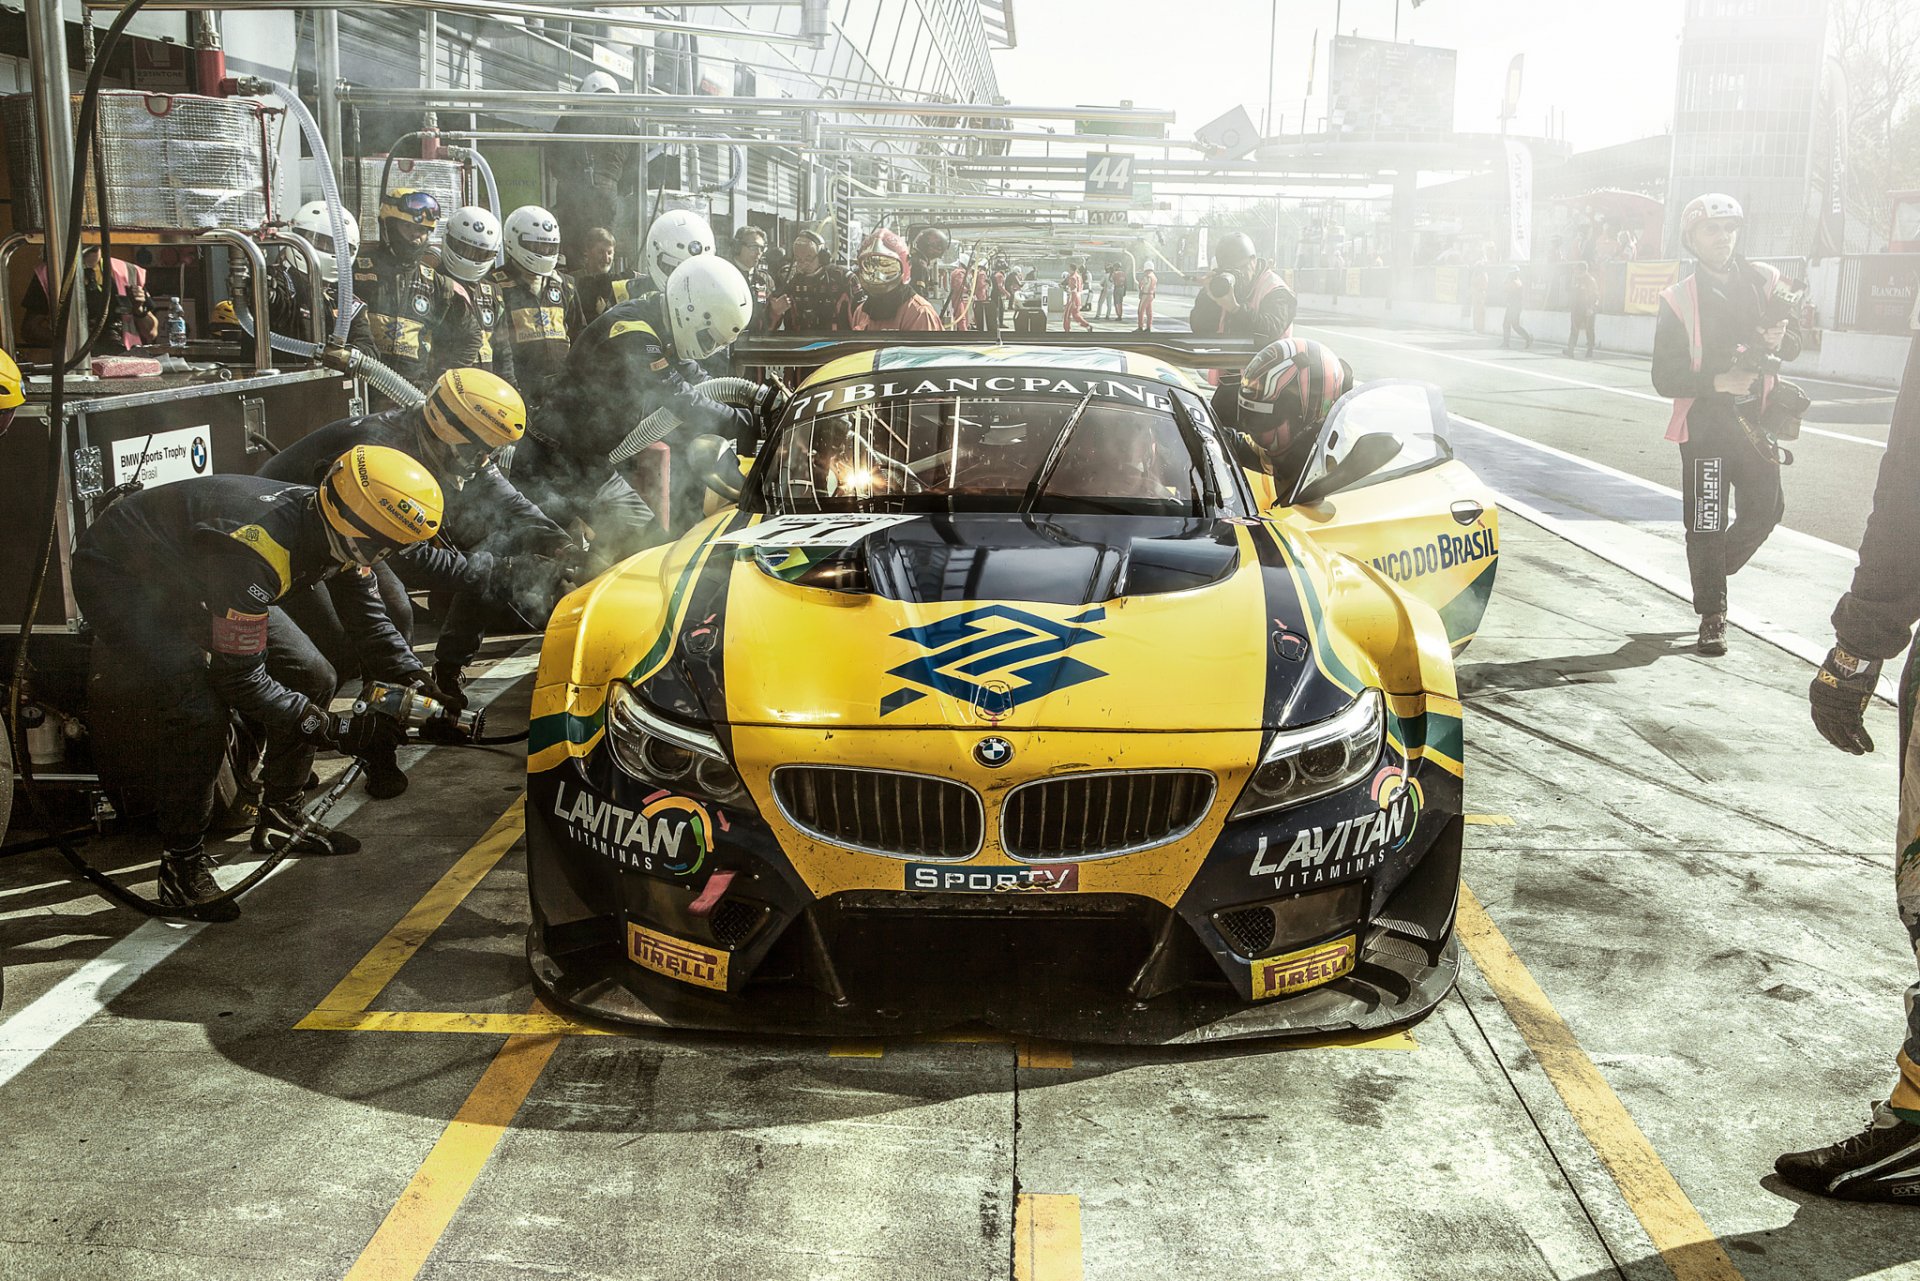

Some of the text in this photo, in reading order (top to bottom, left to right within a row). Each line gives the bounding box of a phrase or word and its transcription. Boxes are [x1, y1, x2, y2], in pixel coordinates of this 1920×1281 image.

[1088, 156, 1131, 190] 44
[835, 159, 849, 265] MOTORRA
[1089, 211, 1127, 226] 41 42
[1871, 284, 1911, 297] BLANCPAIN
[792, 389, 835, 421] 77
[838, 376, 1147, 407] BLANCPAIN
[120, 452, 139, 468] BMW
[163, 444, 187, 460] Trophy
[141, 465, 158, 481] Brasil
[756, 520, 876, 540] 77
[1365, 528, 1499, 583] NCO DO BRASIL
[554, 780, 688, 858] LAVITAN
[1249, 796, 1409, 876] LAVITAN
[568, 825, 653, 871] VITAMINAS
[1274, 849, 1386, 890] VITAMINAS
[634, 930, 718, 981] PIRELLI
[1263, 945, 1348, 991] PIRELLI
